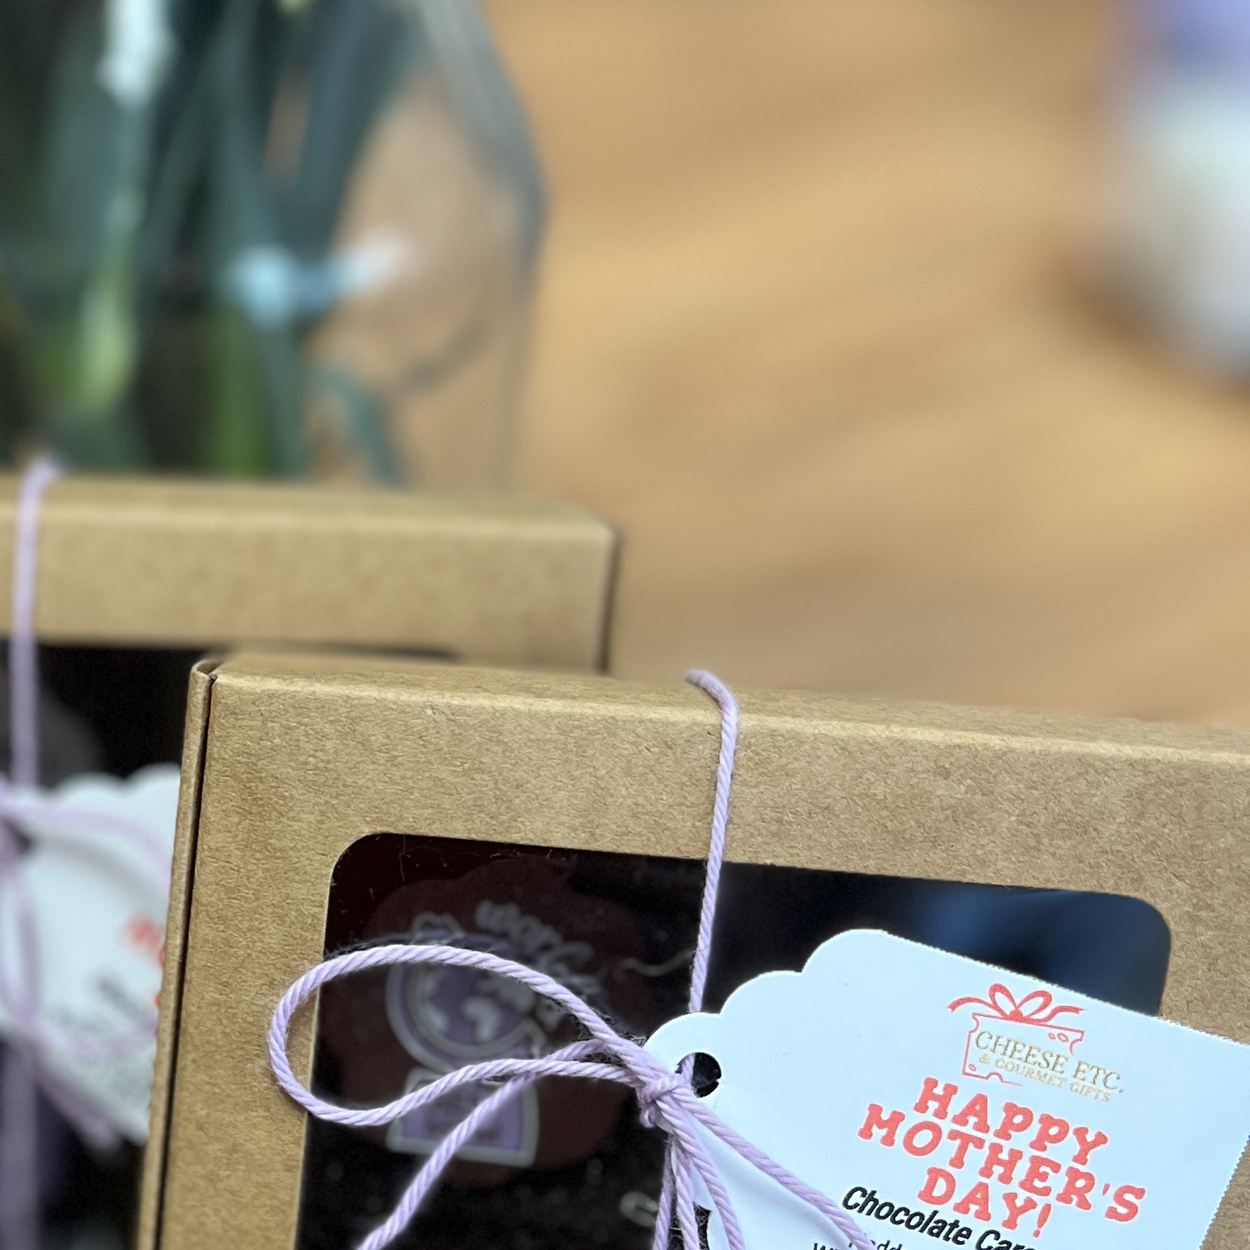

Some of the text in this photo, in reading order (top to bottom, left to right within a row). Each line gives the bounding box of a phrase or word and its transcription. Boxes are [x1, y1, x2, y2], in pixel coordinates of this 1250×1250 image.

[975, 1031, 1124, 1093] CHEESE ETC.
[979, 1053, 1111, 1103] & GOURMET GIFTS
[913, 1077, 1108, 1166] HAPPY
[857, 1103, 1146, 1223] MOTHER'S
[842, 1186, 972, 1246] Chocolate
[917, 1167, 1053, 1238] DAY!
